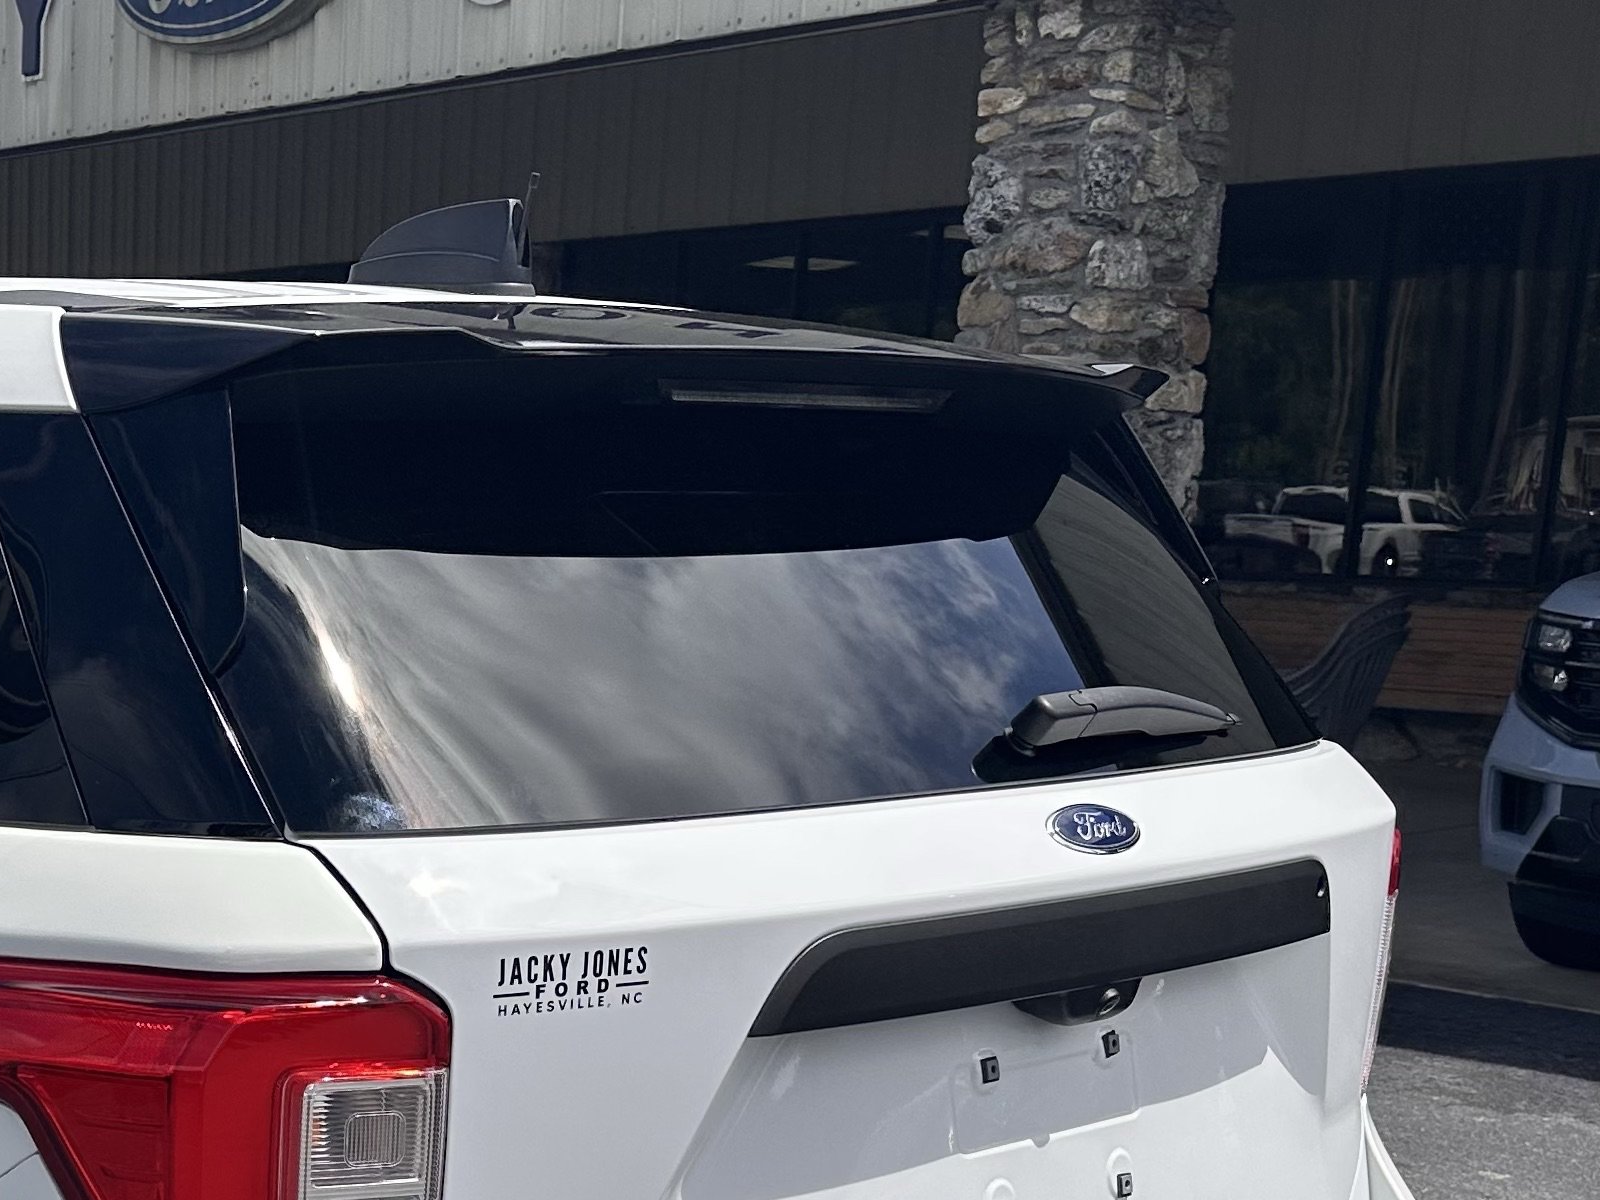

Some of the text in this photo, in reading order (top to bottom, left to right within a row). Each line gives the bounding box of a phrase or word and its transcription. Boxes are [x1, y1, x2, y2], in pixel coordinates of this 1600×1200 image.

[1073, 810, 1127, 841] Ford
[497, 946, 648, 987] JACKY JONES
[535, 978, 610, 1000] FORD
[497, 992, 643, 1017] HAYESVILLE, NC
